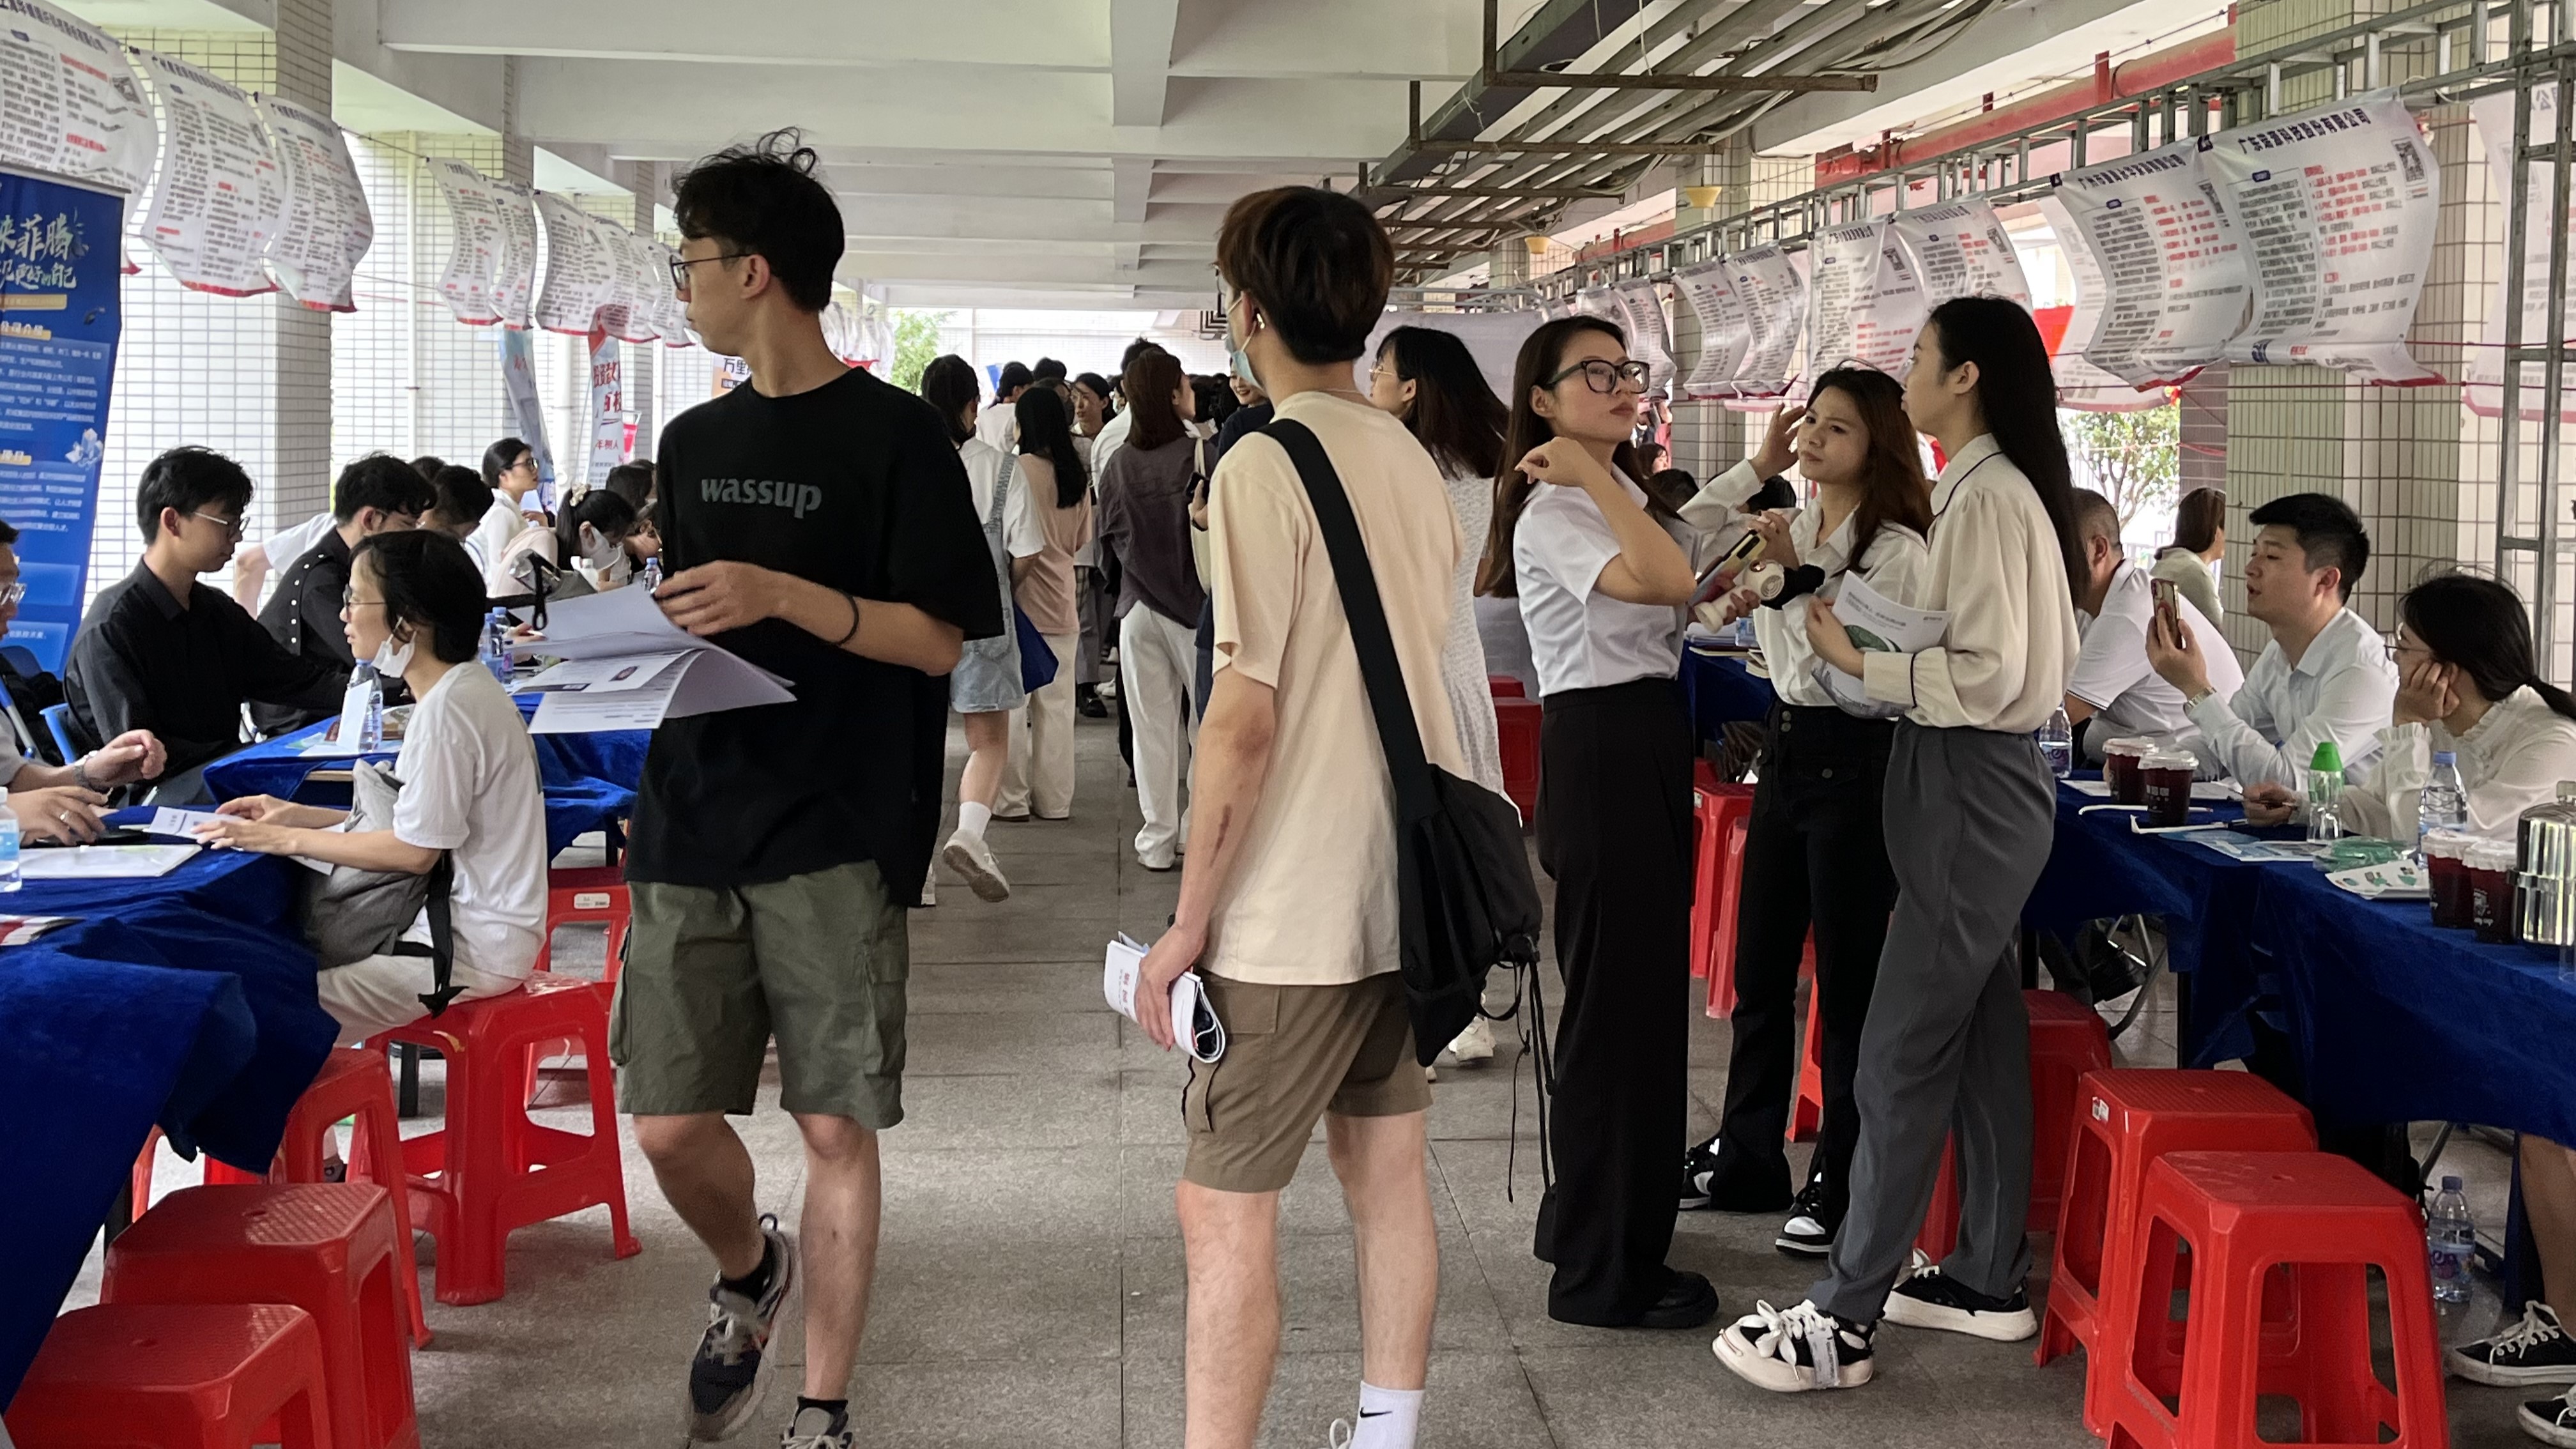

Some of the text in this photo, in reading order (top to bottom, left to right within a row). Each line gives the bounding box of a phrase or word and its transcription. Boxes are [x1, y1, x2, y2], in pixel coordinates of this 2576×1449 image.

[1, 321, 43, 336] 公司介绍
[723, 357, 749, 376] 万里
[701, 479, 822, 519] wassup
